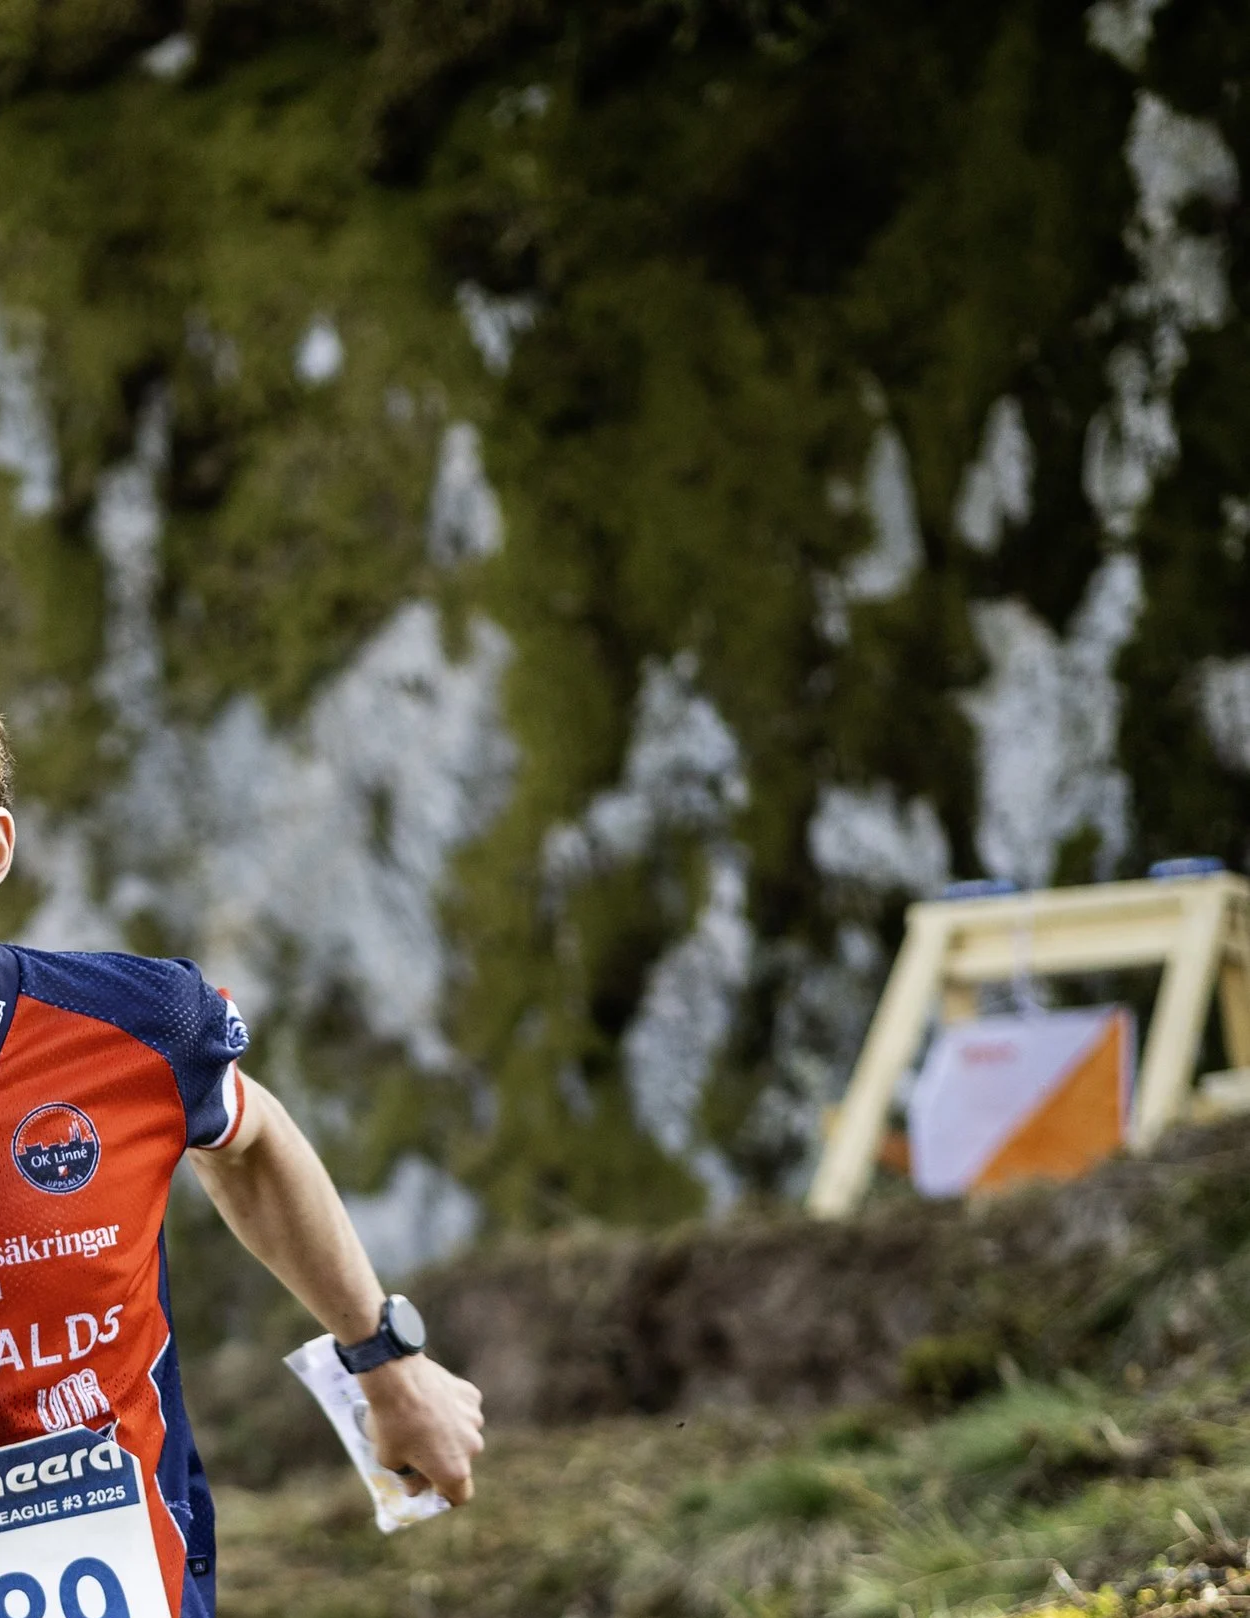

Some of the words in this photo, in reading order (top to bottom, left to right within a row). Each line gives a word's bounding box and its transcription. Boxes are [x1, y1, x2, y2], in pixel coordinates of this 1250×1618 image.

[31, 1153, 51, 1168] OK
[54, 1145, 88, 1163] Linné
[46, 1174, 83, 1188] UPPSALA
[61, 1495, 84, 1512] #3
[87, 1484, 127, 1506] 2025
